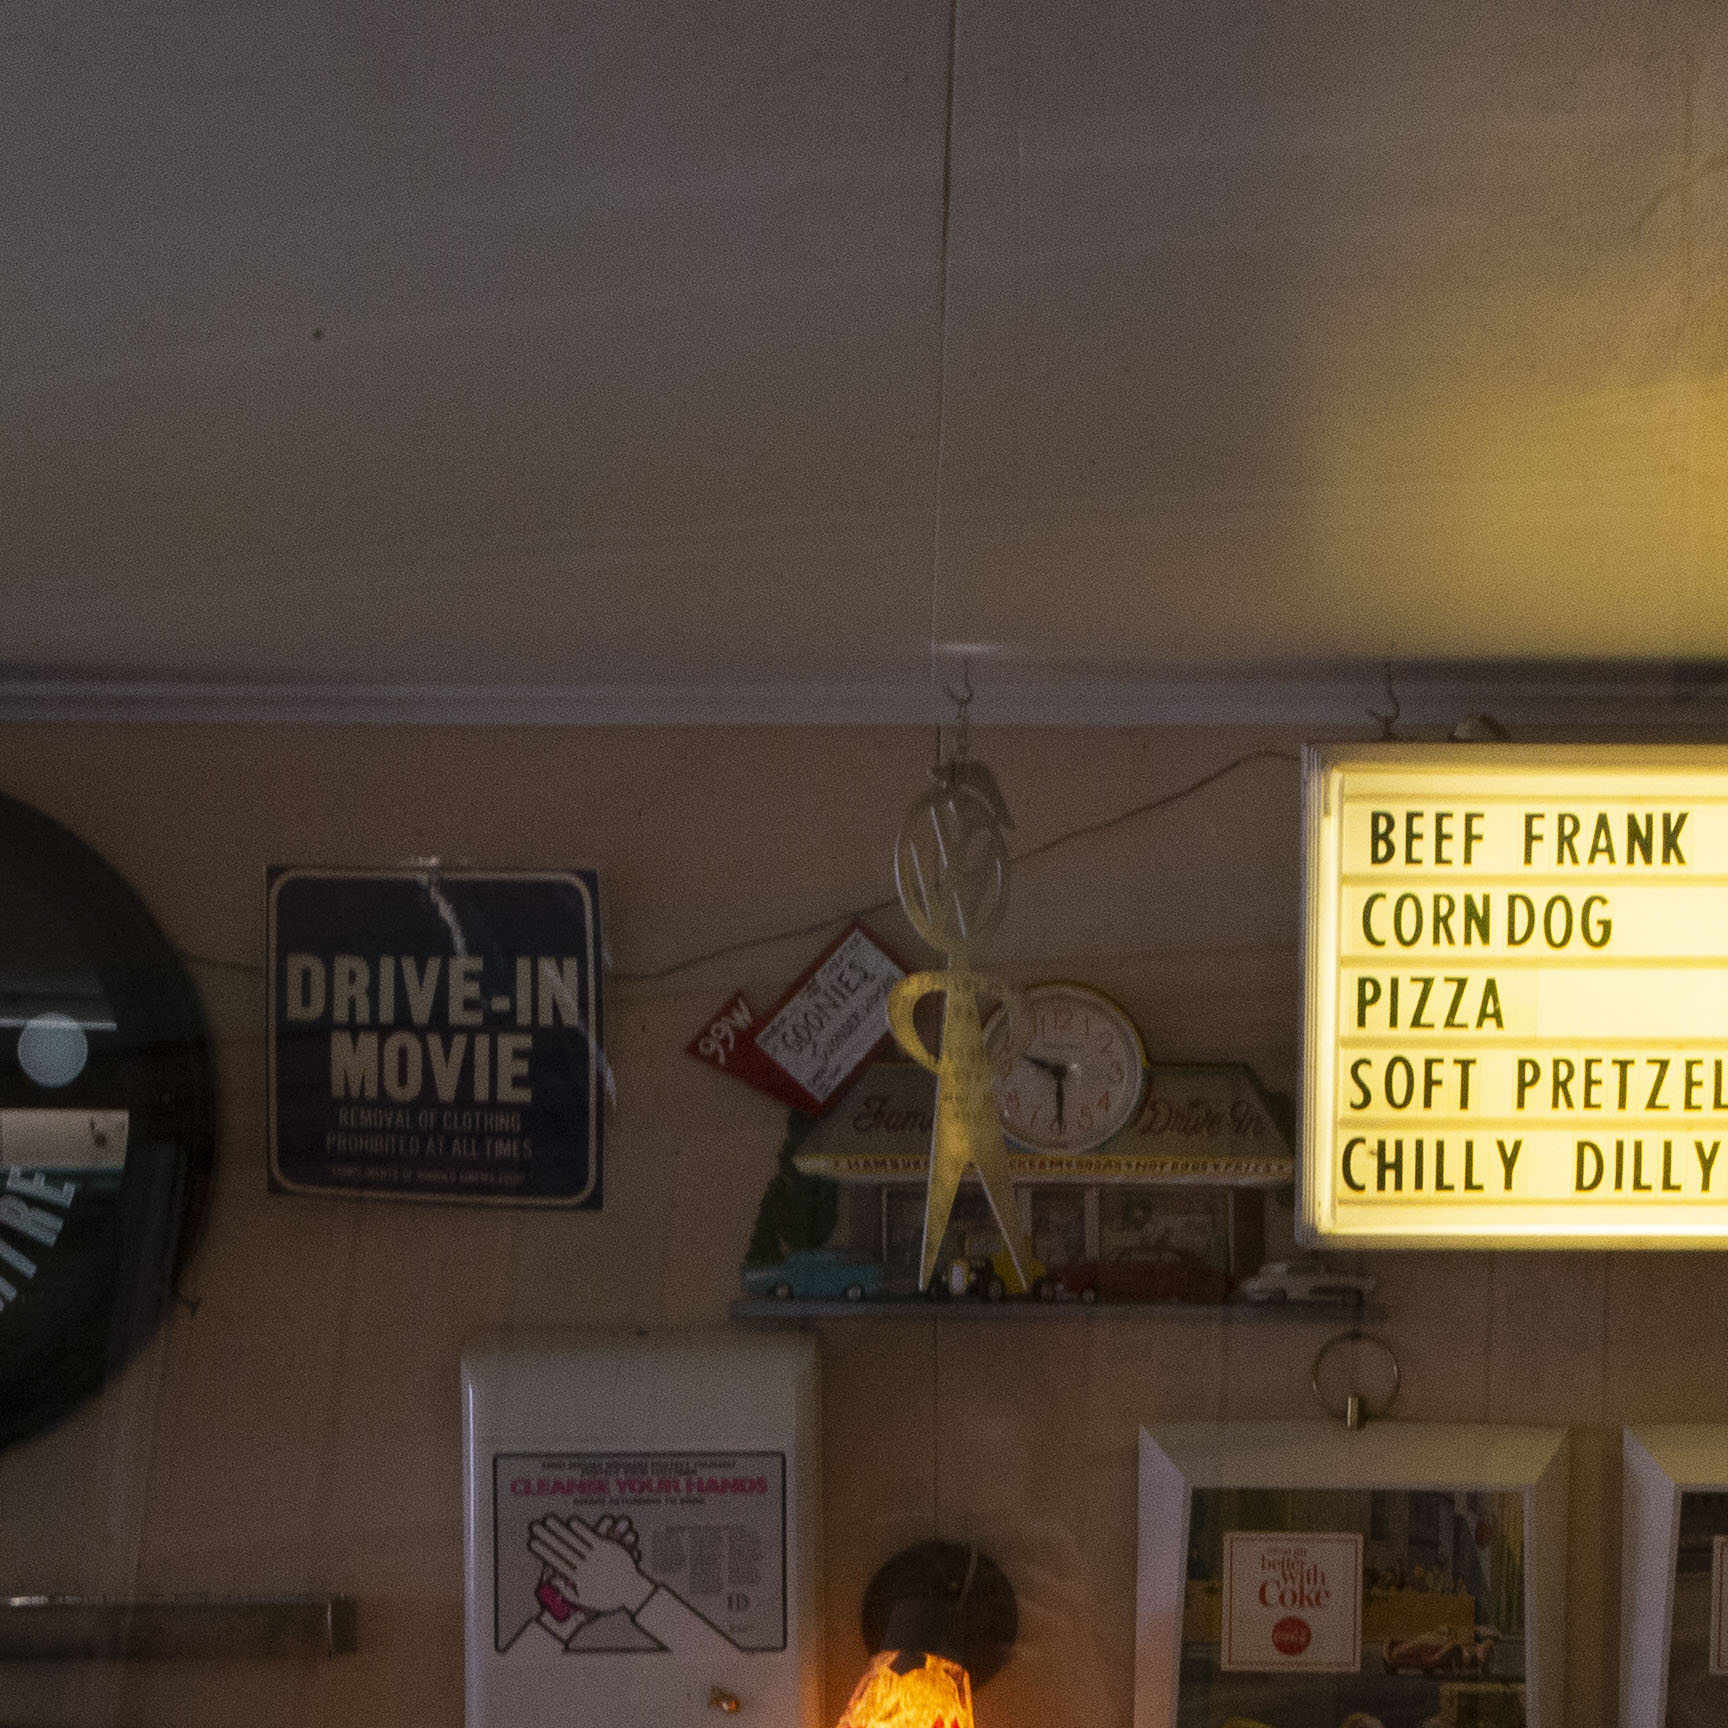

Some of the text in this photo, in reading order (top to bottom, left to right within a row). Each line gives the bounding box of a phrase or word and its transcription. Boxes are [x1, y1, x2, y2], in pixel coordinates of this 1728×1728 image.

[1370, 811, 1484, 866] BEEF
[1523, 811, 1689, 866] FRANK
[287, 953, 580, 1029] DRIVE-IN
[1357, 976, 1504, 1030] PIZZA
[699, 998, 752, 1065] 99W
[330, 1030, 533, 1106] MOVIE
[1350, 1055, 1477, 1111] SOFT
[418, 1109, 438, 1131] OF
[442, 1110, 522, 1133] CLOTHING
[425, 1135, 446, 1156] AT
[450, 1137, 479, 1159] ALL
[1342, 1137, 1522, 1192] CHILLY
[1575, 1139, 1722, 1192] DILLY
[509, 1475, 769, 1497] CLEANSE YOUR HANDS
[1258, 1579, 1331, 1609] Coke
